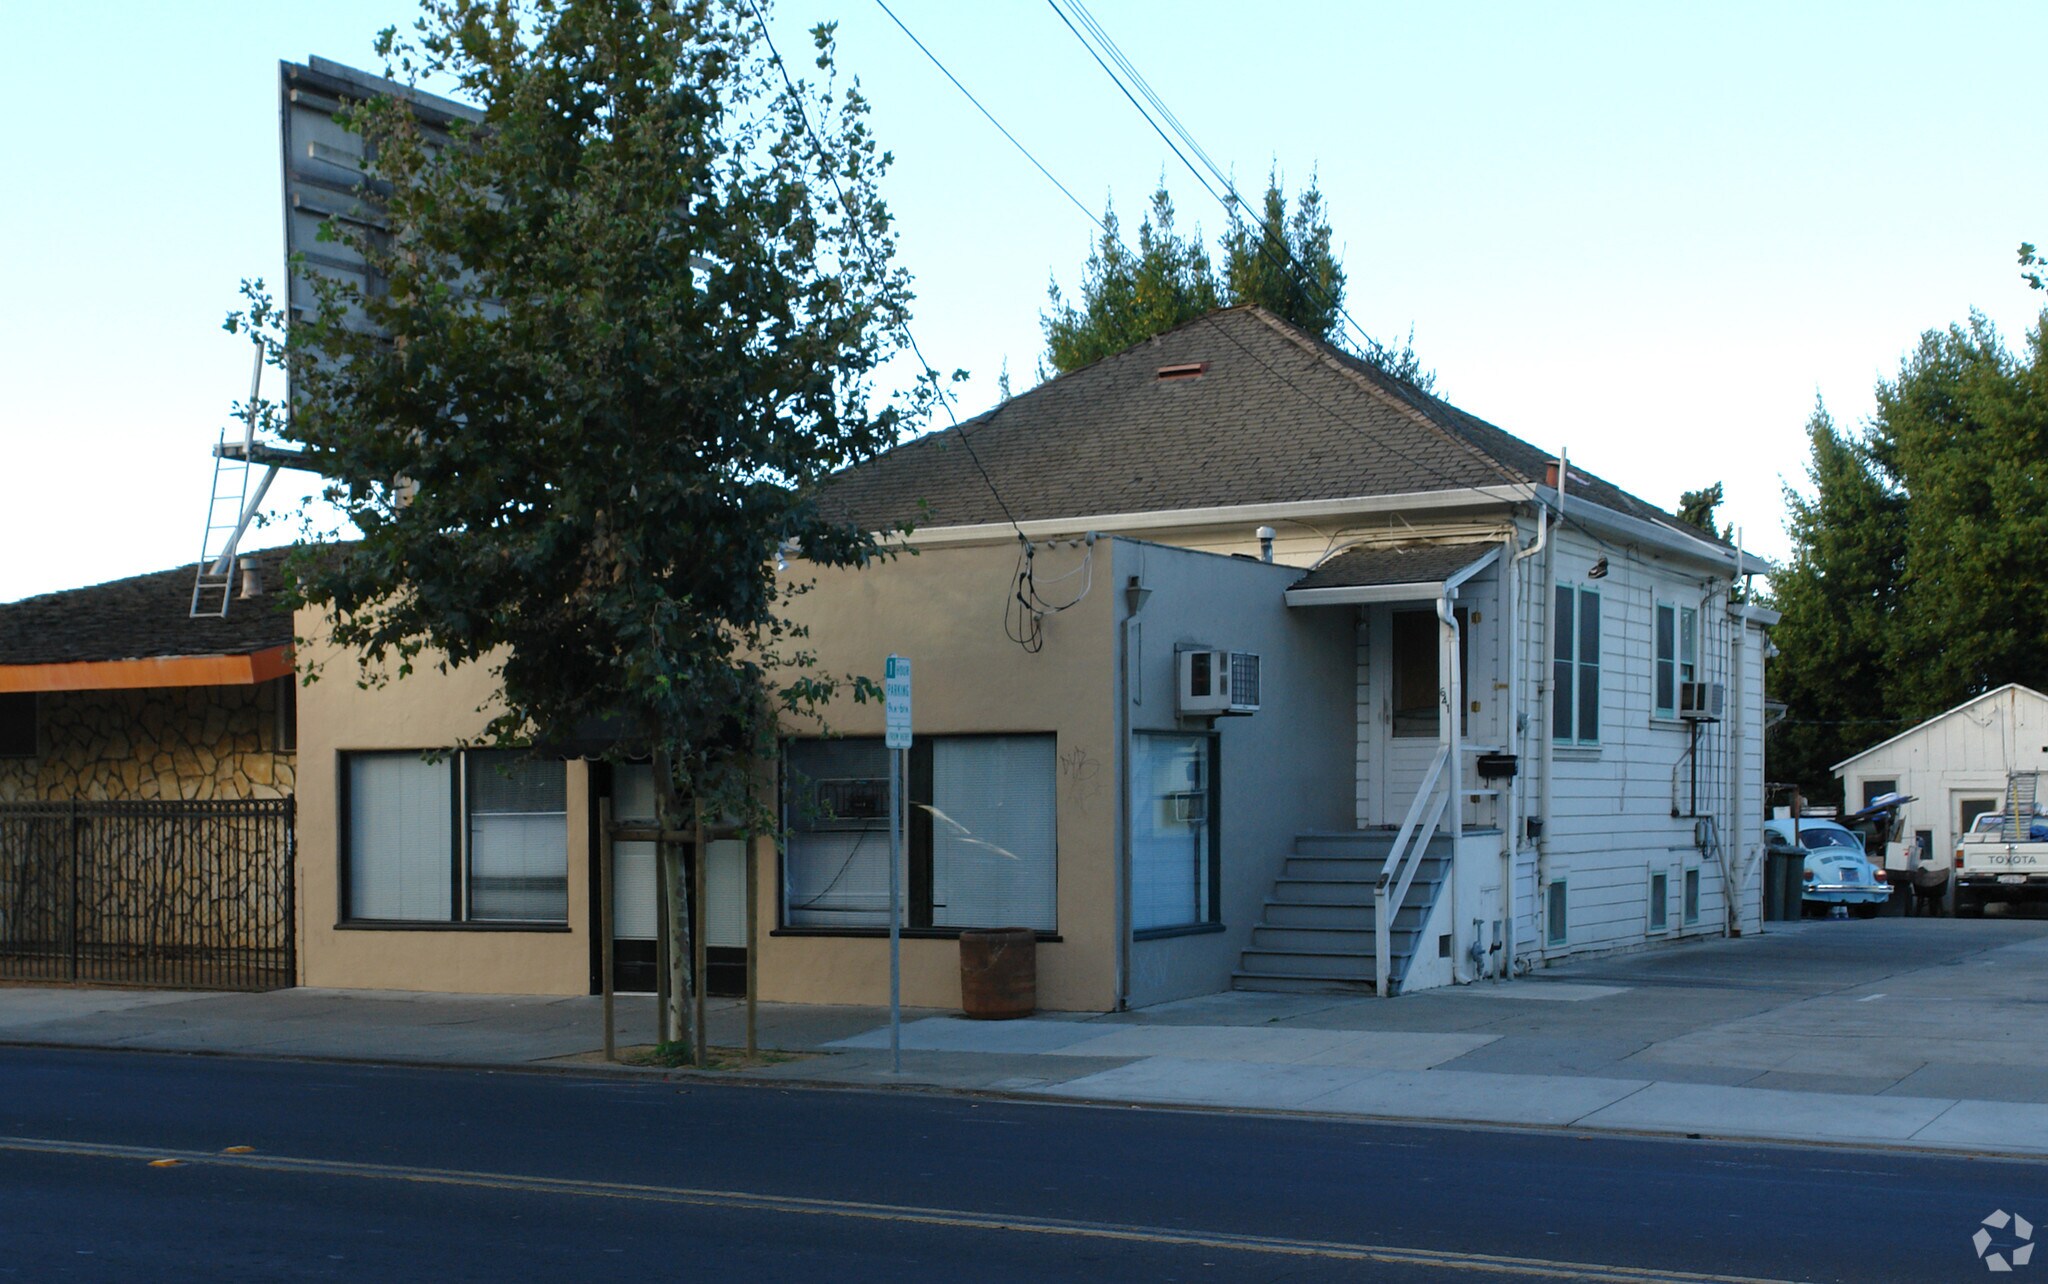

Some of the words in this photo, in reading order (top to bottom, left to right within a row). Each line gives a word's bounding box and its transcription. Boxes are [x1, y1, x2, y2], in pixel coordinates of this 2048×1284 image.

[887, 683, 909, 697] PARKING
[1440, 687, 1450, 714] 641
[1988, 855, 2037, 865] TOYOTA
